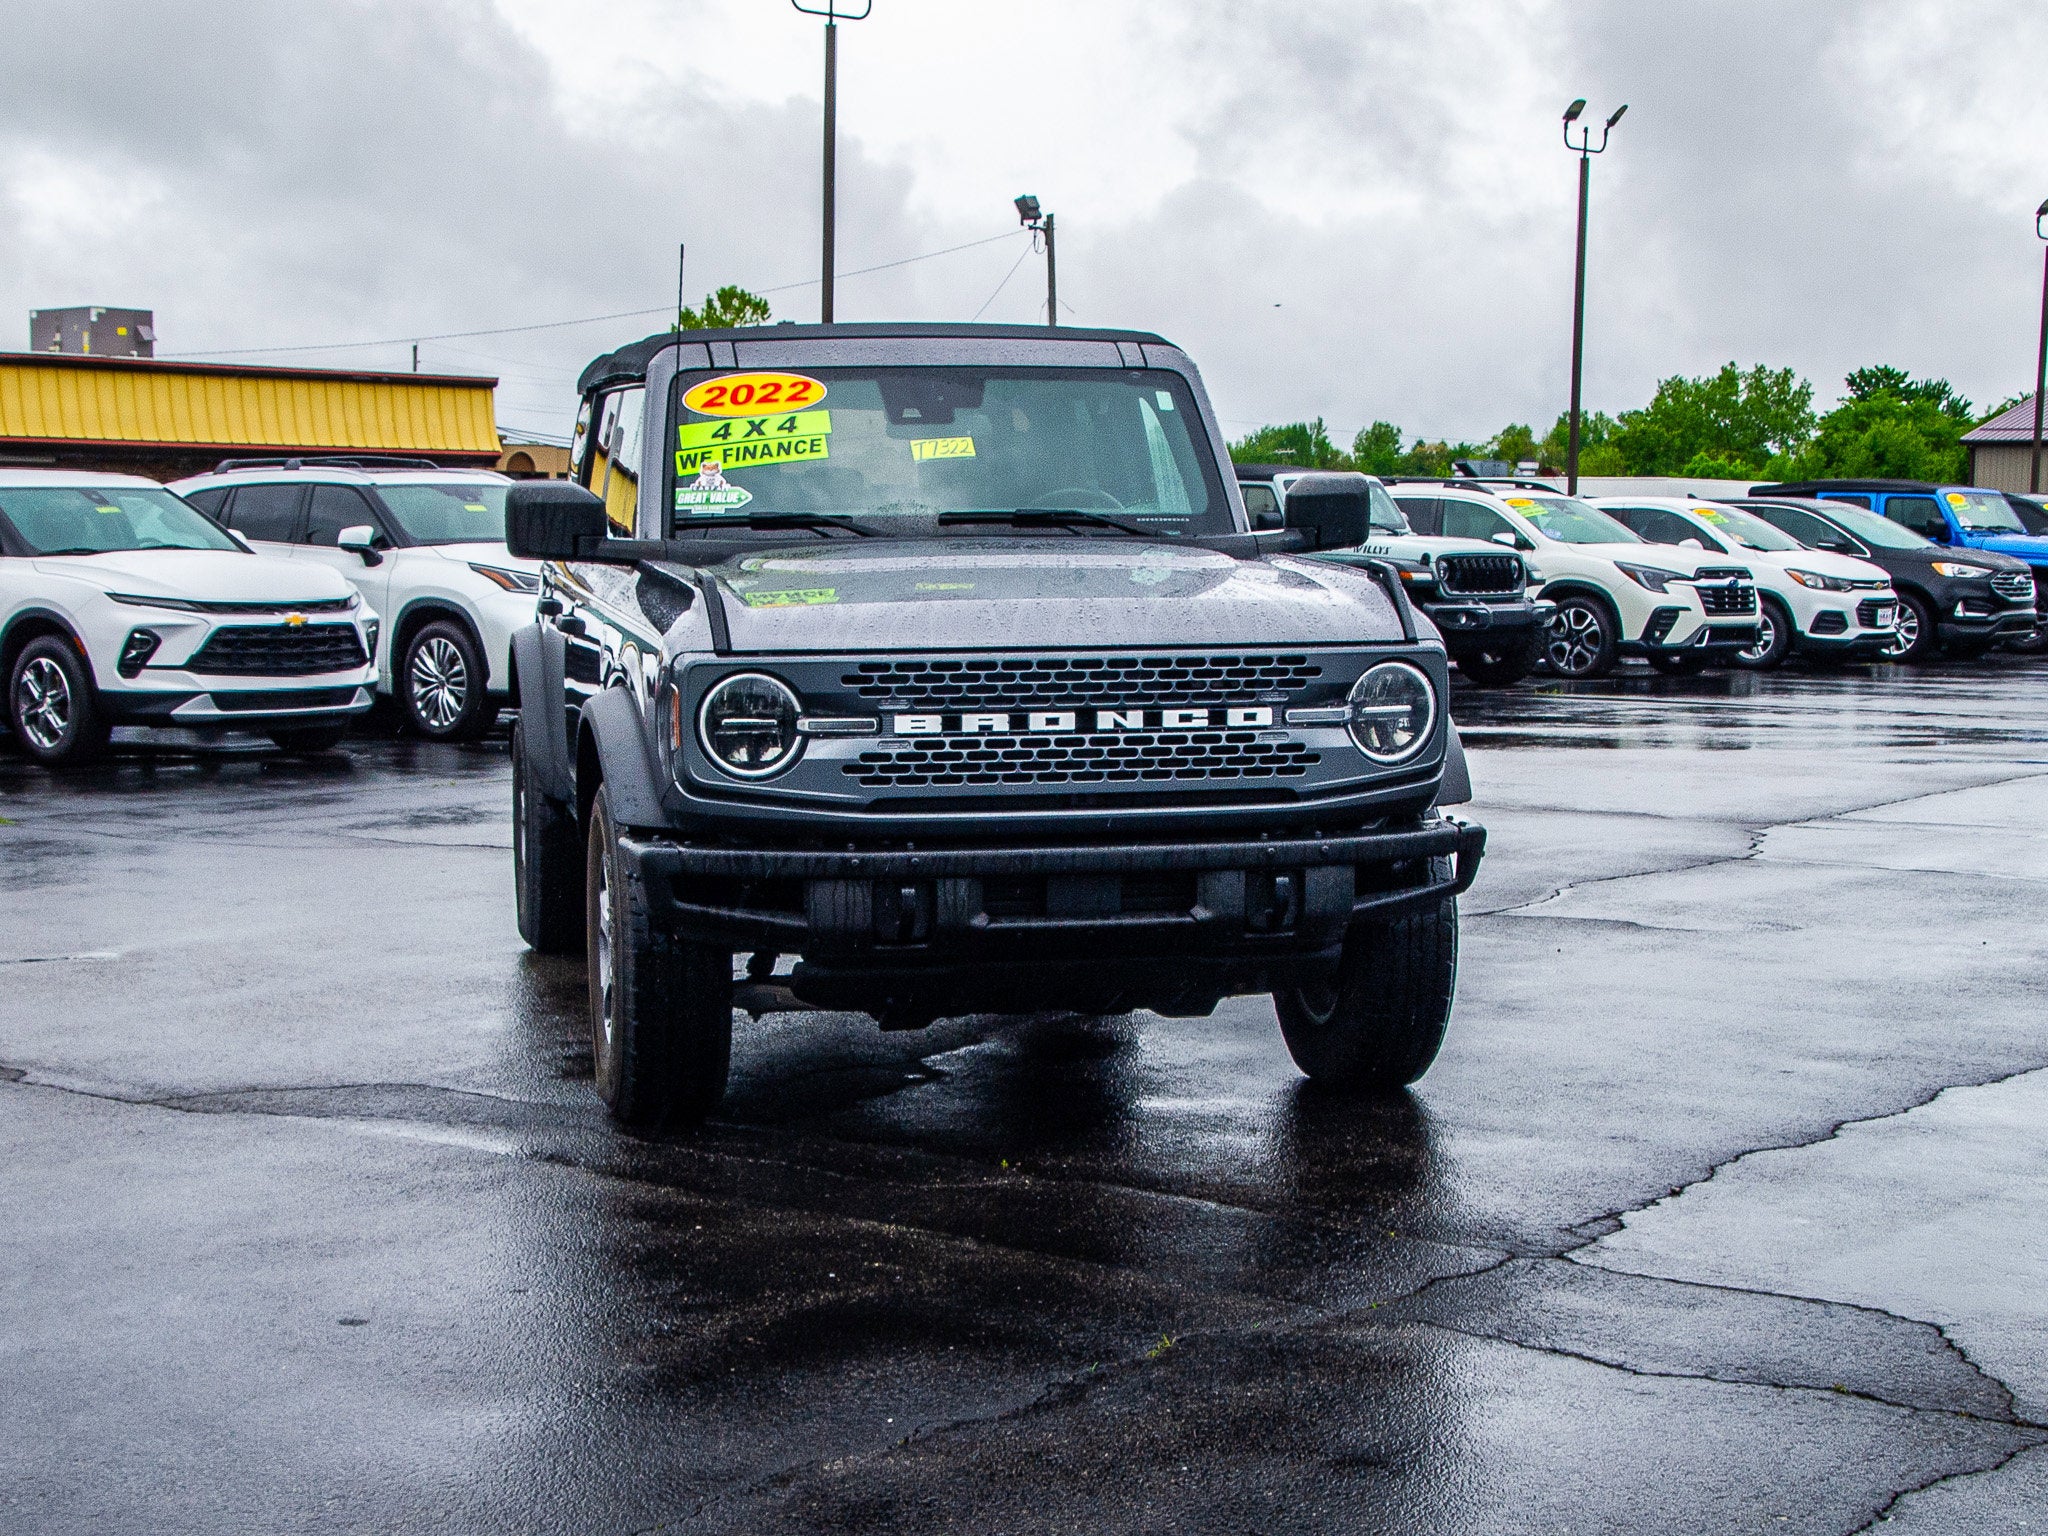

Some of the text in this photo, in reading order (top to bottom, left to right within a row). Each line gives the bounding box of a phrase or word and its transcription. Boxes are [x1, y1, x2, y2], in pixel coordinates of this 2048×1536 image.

[701, 381, 812, 409] 2022
[711, 415, 797, 441] 4 X 4
[722, 438, 822, 464] FINANCE
[913, 439, 973, 460] T7322
[677, 490, 741, 505] GREAT VALUE
[1353, 545, 1392, 555] WILLYS
[893, 707, 1273, 734] BRONCO
